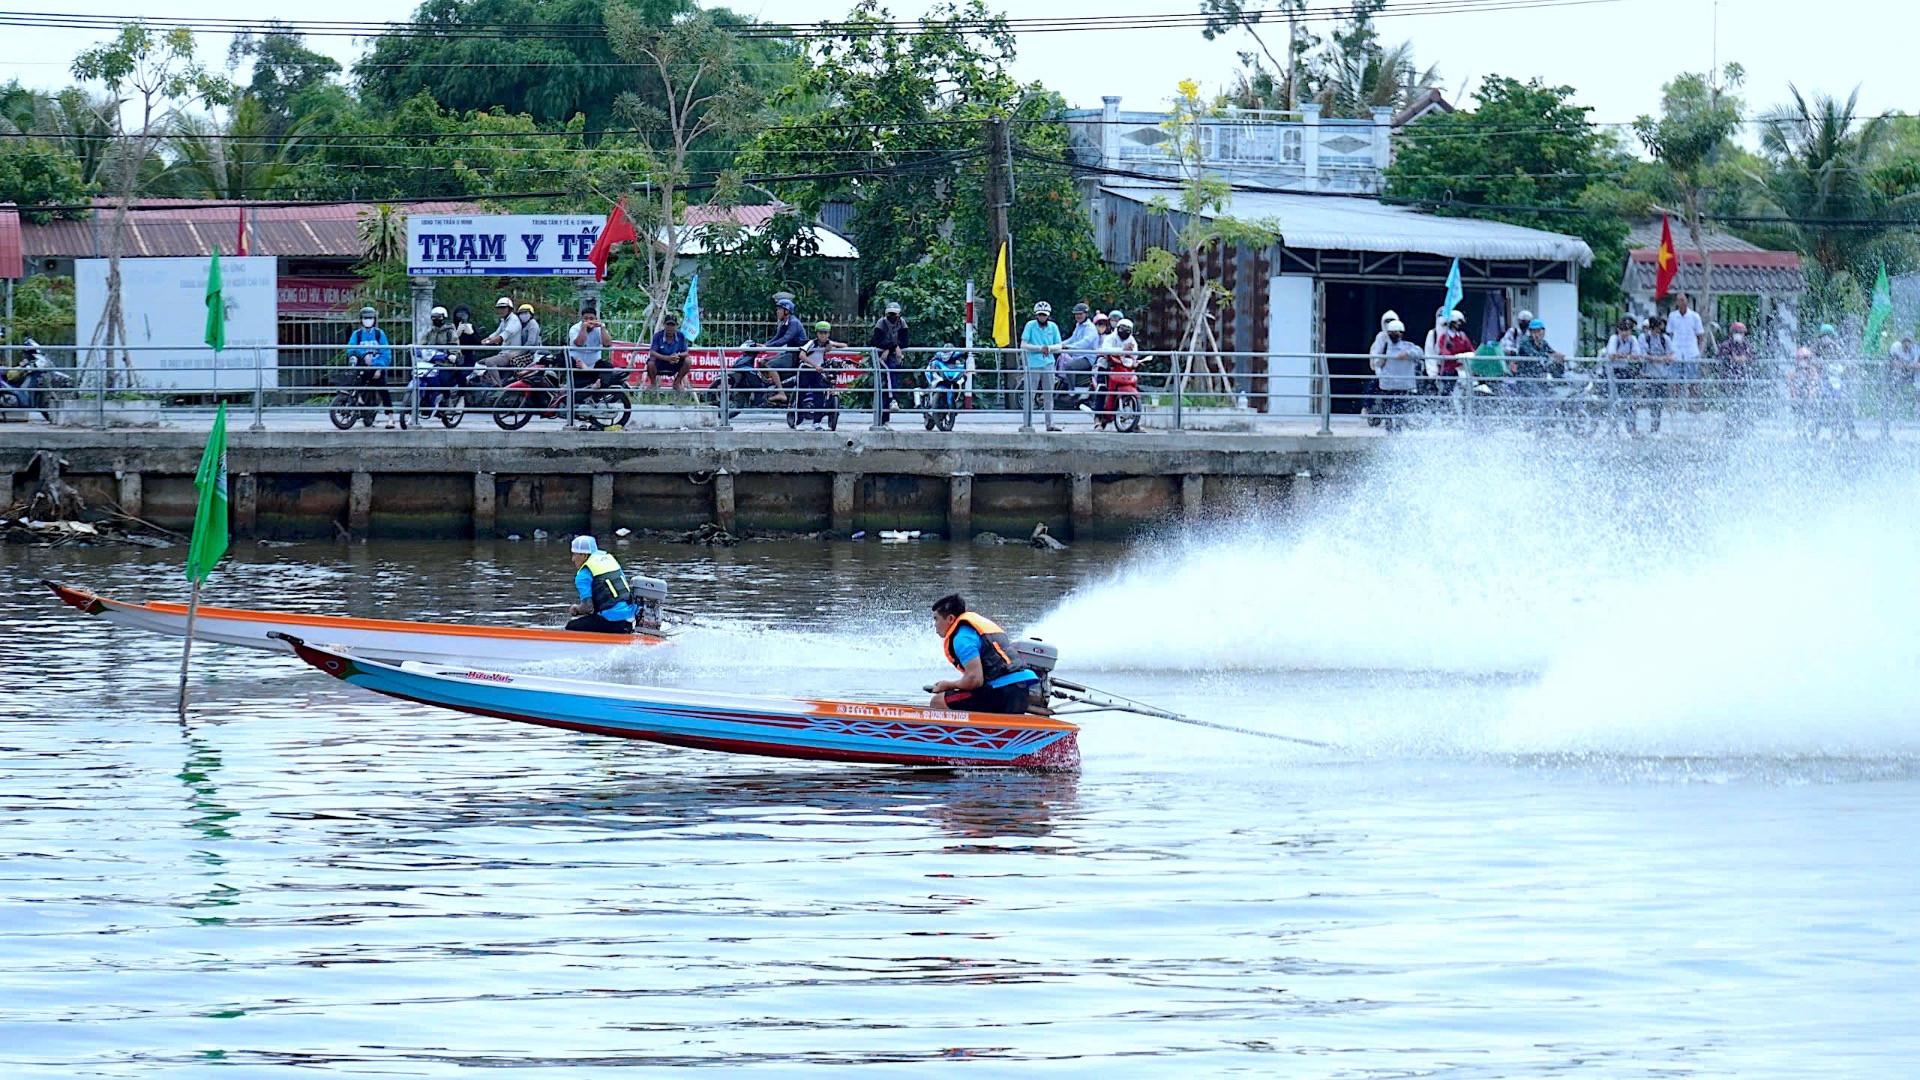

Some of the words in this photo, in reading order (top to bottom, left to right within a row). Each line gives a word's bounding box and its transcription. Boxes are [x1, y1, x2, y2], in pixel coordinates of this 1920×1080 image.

[418, 233, 507, 266] TRẠM
[521, 233, 544, 262] Y
[557, 225, 600, 262] TẾ
